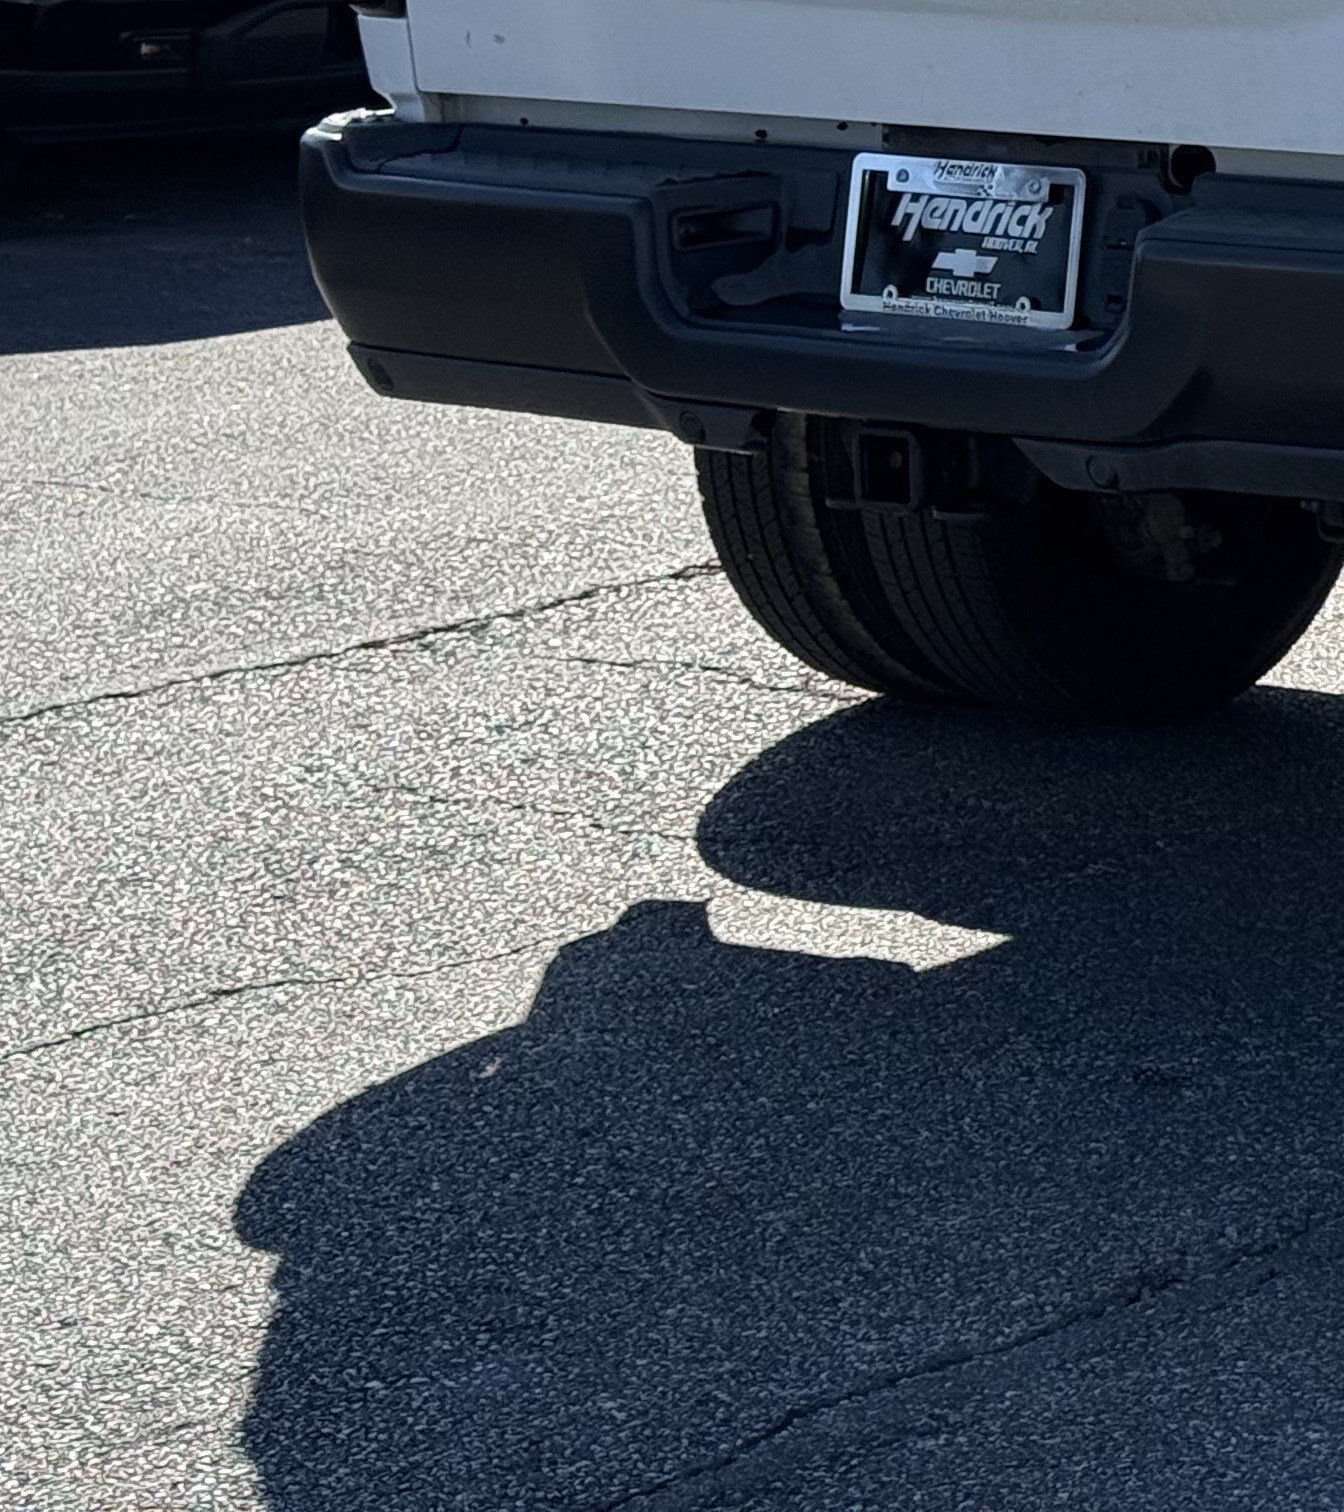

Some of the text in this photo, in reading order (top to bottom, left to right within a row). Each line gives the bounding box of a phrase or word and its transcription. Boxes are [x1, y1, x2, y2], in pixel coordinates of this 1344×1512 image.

[933, 160, 999, 180] Hendrick
[891, 193, 1054, 241] Hendrick
[925, 276, 1001, 299] CHEVROLET
[882, 300, 931, 316] Hendrick
[934, 304, 987, 322] Chevrolet
[988, 309, 1030, 325] Hoover
